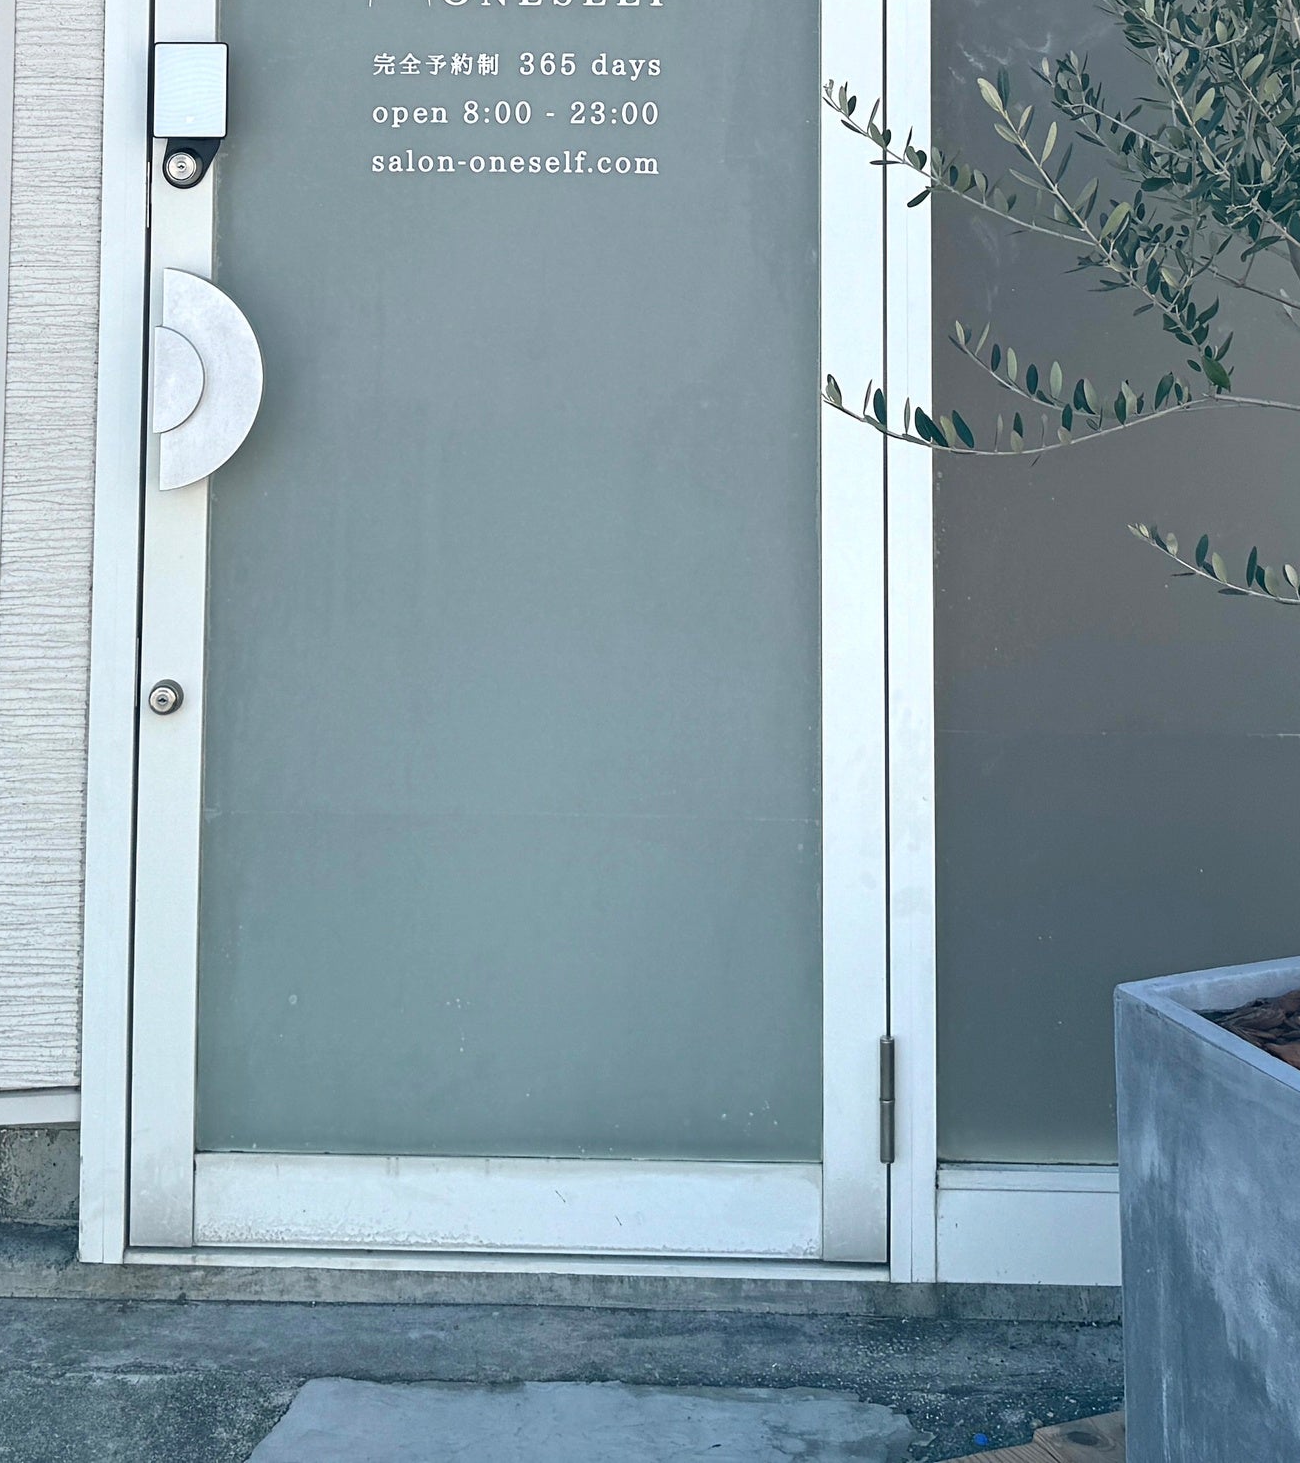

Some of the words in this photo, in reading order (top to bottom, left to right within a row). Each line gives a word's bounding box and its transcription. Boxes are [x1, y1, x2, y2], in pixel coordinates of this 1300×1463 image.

[372, 53, 500, 77] 完全予約制
[519, 52, 577, 76] 365
[591, 53, 661, 81] days
[372, 102, 449, 128] open
[463, 101, 532, 125] 8:00
[570, 101, 660, 125] 23:00
[372, 149, 660, 175] salon-oneself.com
